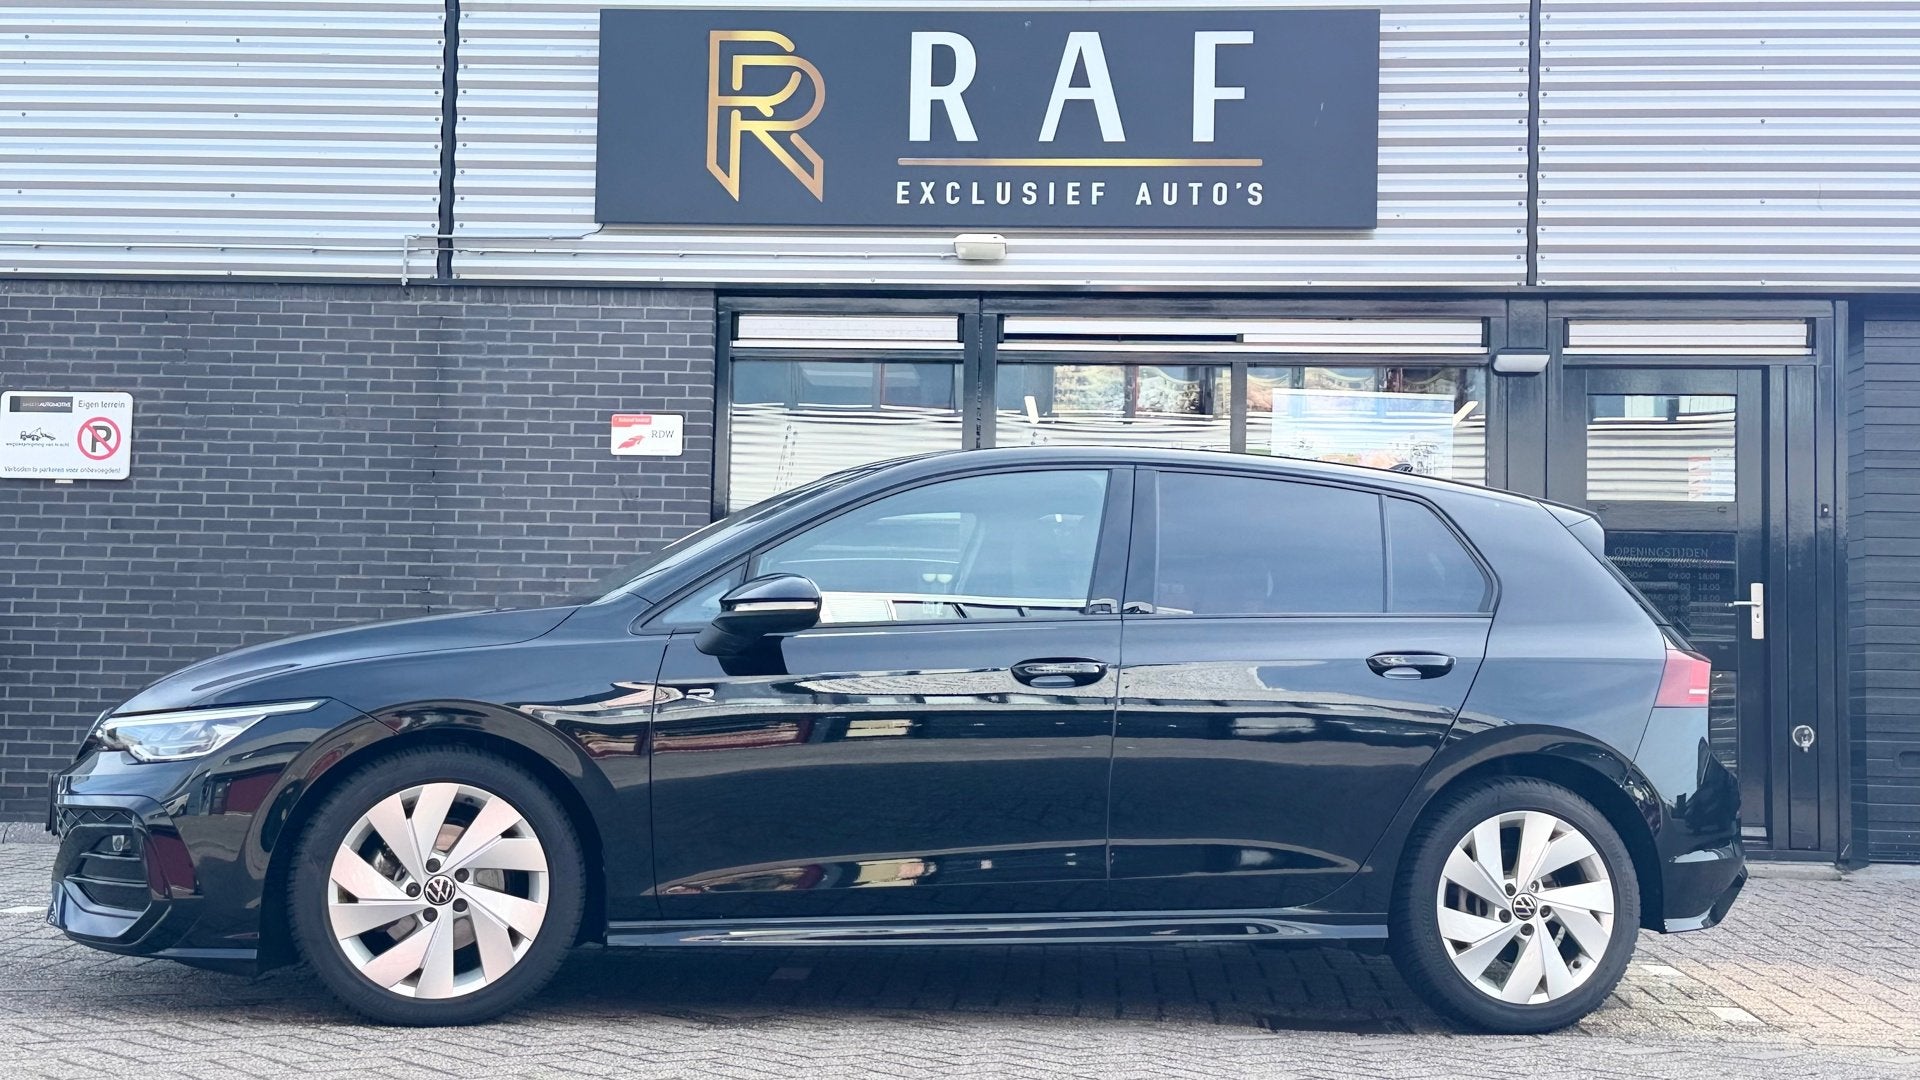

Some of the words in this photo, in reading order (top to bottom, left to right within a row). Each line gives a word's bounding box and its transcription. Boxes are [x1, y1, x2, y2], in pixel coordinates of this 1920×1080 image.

[910, 31, 1253, 141] RAF
[897, 182, 1105, 205] EXCLUSIEF
[1136, 183, 1262, 205] AUTO'S
[78, 399, 100, 410] Eigen
[101, 401, 126, 409] terrein
[651, 430, 675, 438] RDW
[685, 688, 716, 703] R
